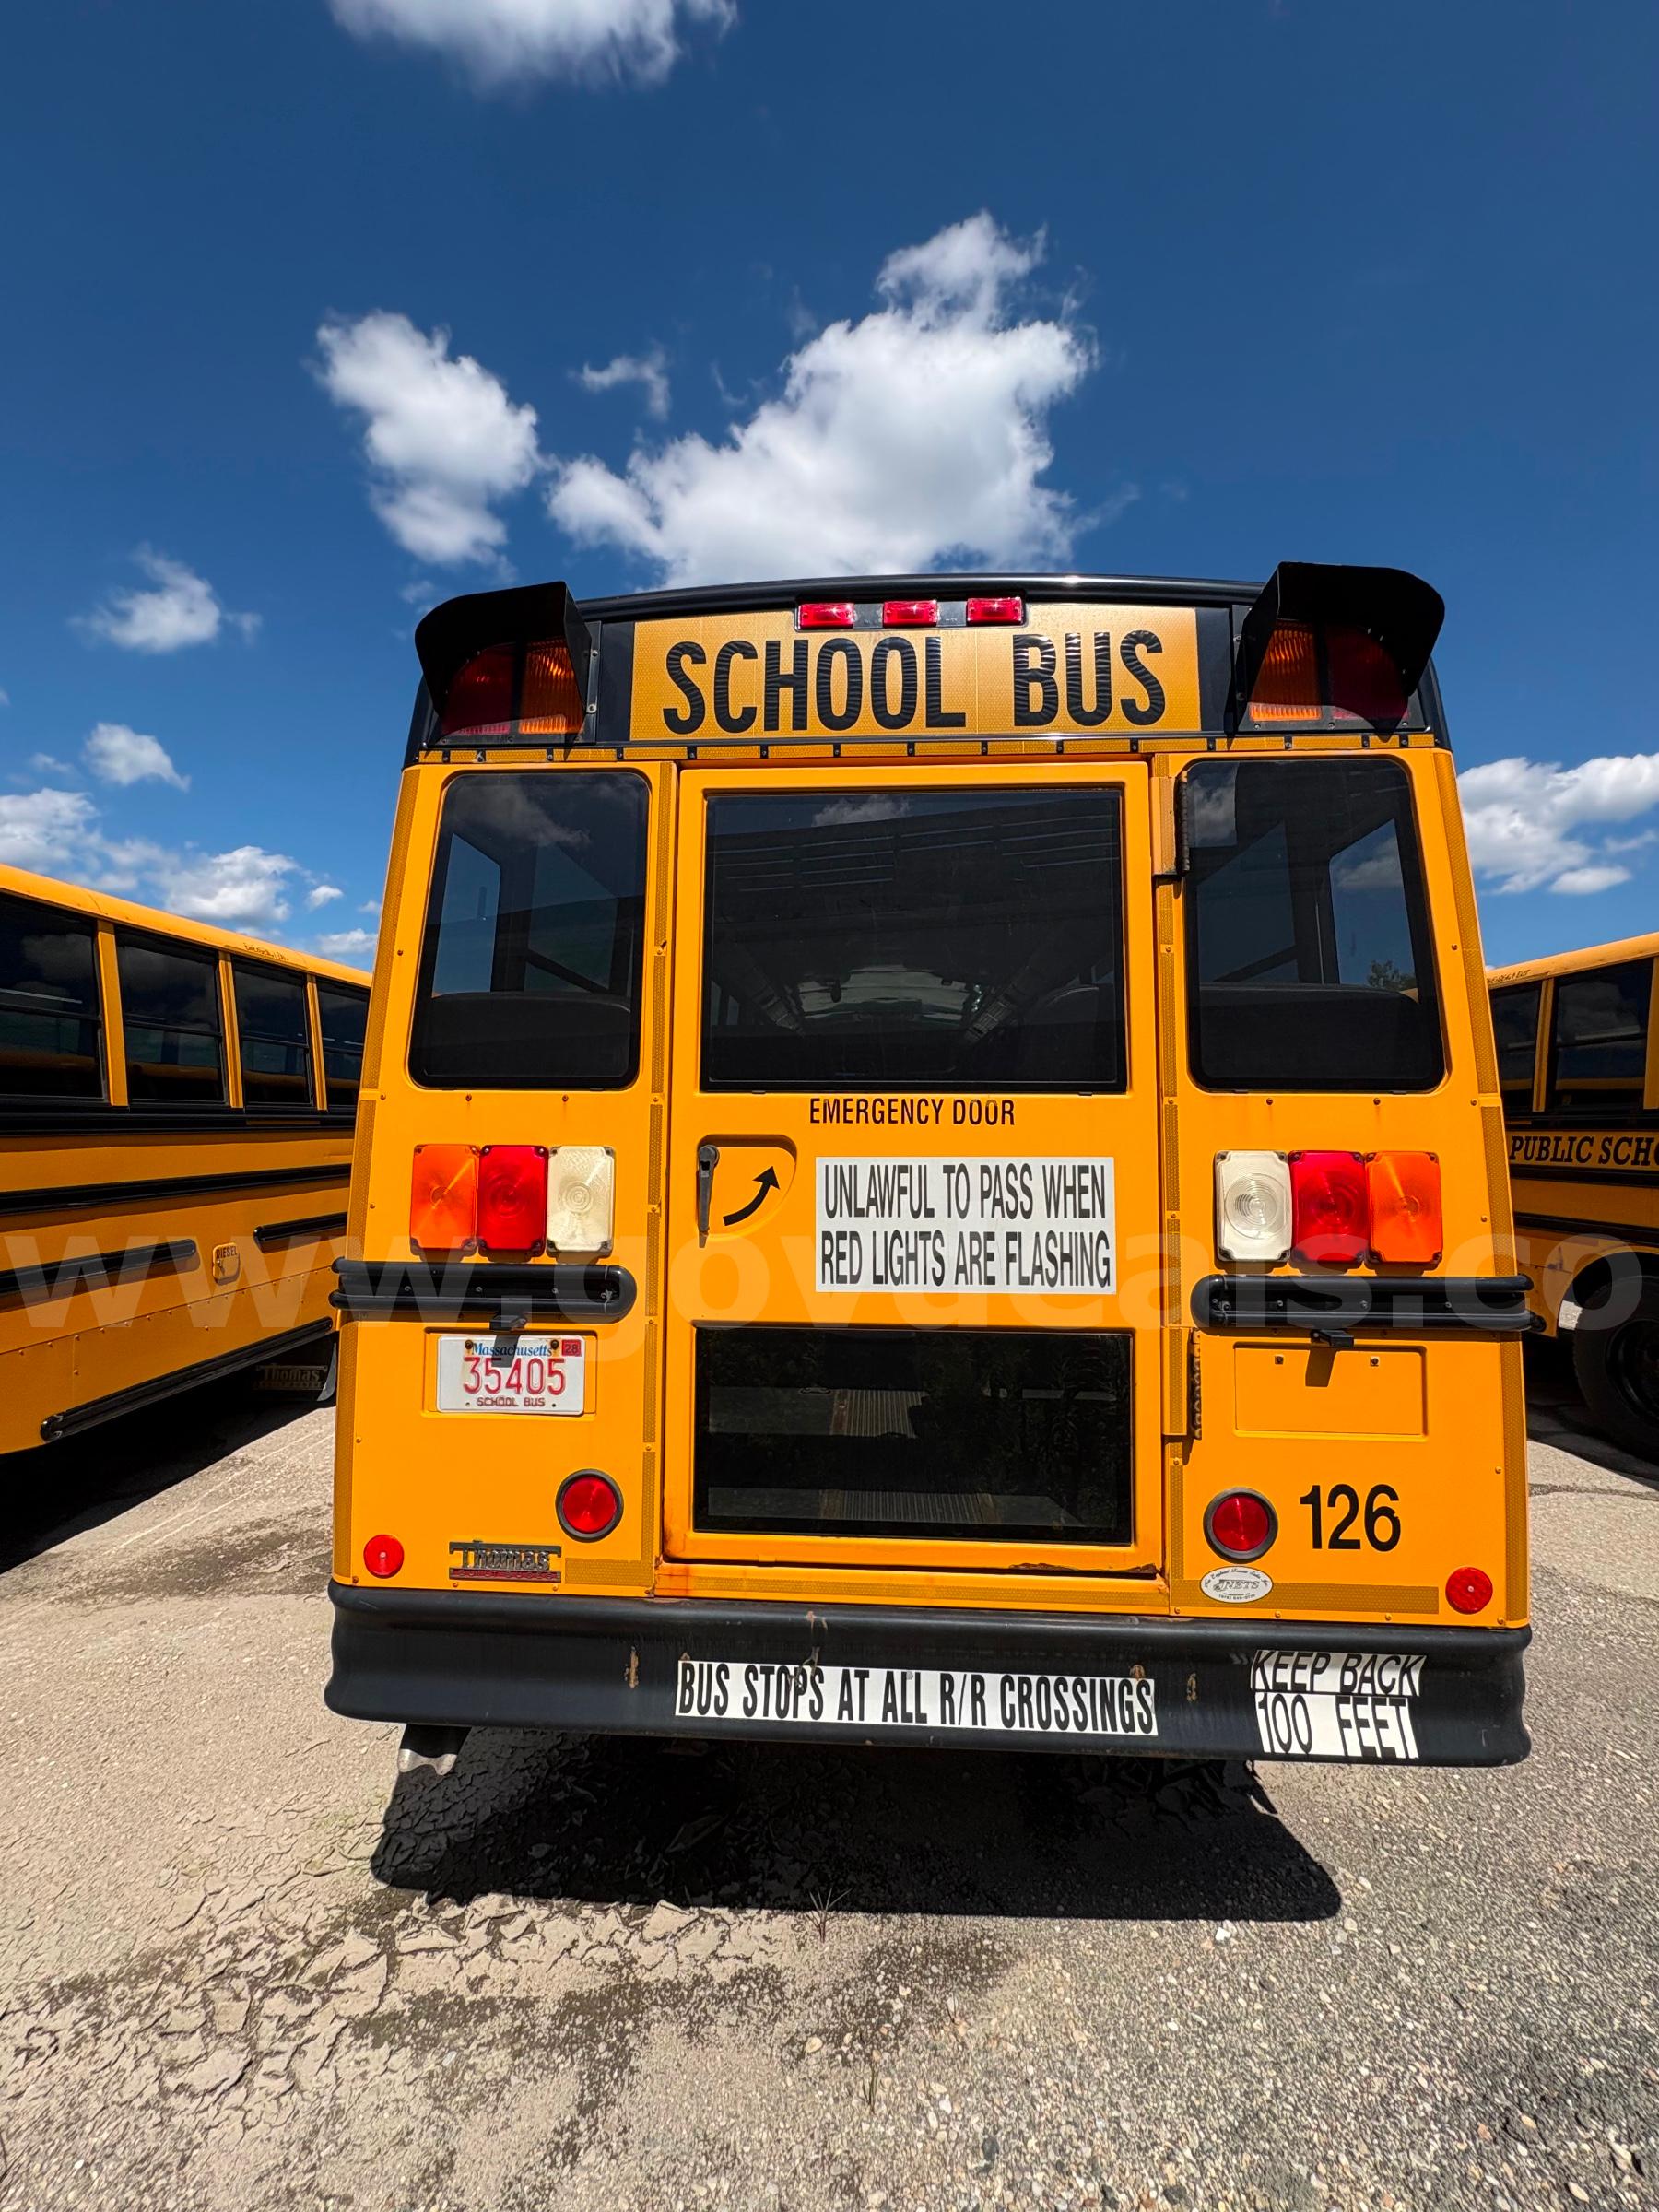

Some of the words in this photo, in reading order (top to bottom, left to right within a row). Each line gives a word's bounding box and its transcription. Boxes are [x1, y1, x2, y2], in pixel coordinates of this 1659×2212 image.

[663, 637, 966, 735] SCHOOL
[1014, 629, 1166, 727] BUS
[810, 1098, 945, 1125] EMERGENCY
[953, 1100, 1015, 1126] DOOR
[1510, 1135, 1594, 1163] PUBLIC
[1598, 1136, 1659, 1166] SCH
[825, 1164, 935, 1219] UNLAWFUL
[943, 1163, 971, 1219] TO
[980, 1163, 1033, 1219] PASS
[1042, 1165, 1105, 1218] WHEN
[216, 1245, 238, 1259] DIESEL
[821, 1230, 863, 1285] RED
[872, 1230, 945, 1287] LIGHTS
[955, 1231, 996, 1285] ARE
[1006, 1230, 1111, 1288] FLASHING
[471, 1342, 553, 1357] Massachusetts
[565, 1343, 580, 1354] 28
[463, 1357, 566, 1395] 35405
[477, 1396, 519, 1406] SCHOOL
[524, 1397, 546, 1407] BUS
[1299, 1483, 1401, 1552] 126
[456, 1543, 556, 1571] Thomas
[1253, 1650, 1331, 1693] KEEP
[1340, 1653, 1426, 1696] BACK
[678, 1662, 730, 1716] BUS
[743, 1665, 825, 1720] STOPS
[837, 1669, 870, 1721] AT
[882, 1671, 927, 1724] ALL
[940, 1673, 986, 1726] R/R
[1000, 1675, 1153, 1734] CROSSINGS
[1257, 1693, 1312, 1754] 100
[1335, 1695, 1410, 1759] FEET
